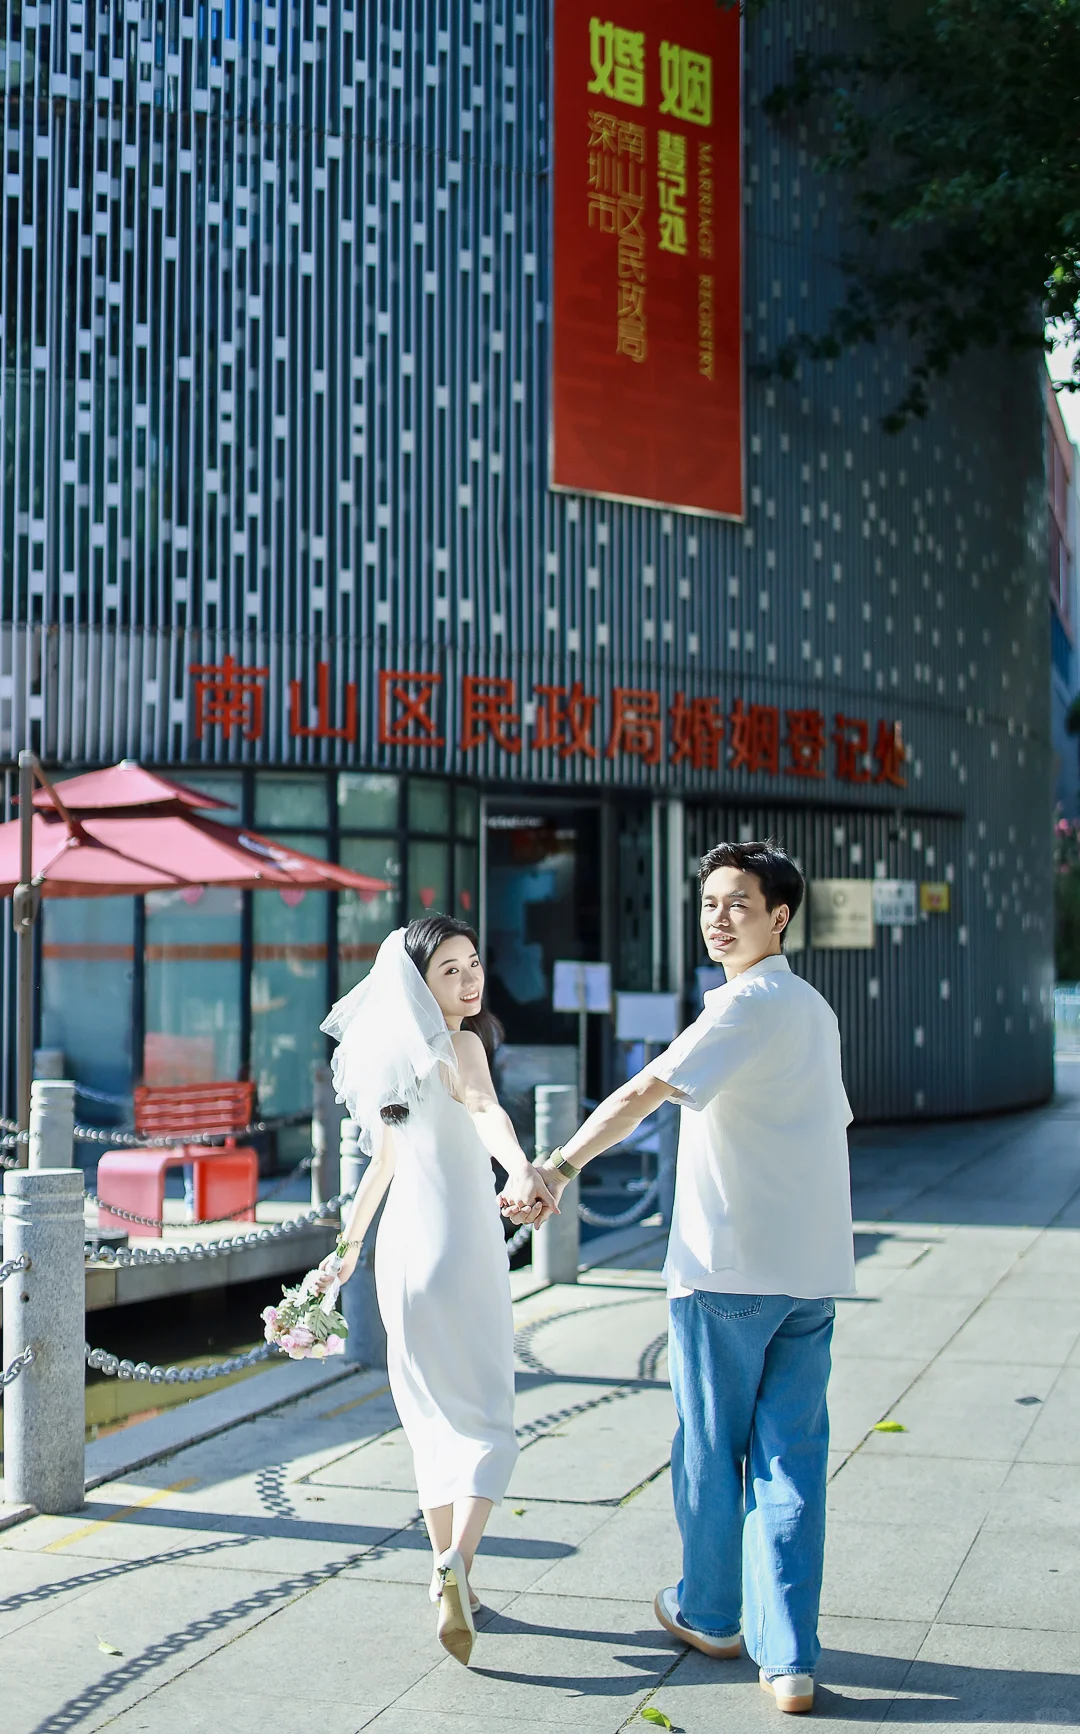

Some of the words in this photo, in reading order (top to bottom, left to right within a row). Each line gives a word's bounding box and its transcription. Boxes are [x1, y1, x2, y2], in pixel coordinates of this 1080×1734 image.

[587, 16, 712, 127] 婚姻
[587, 109, 617, 235] 深圳市
[657, 131, 688, 256] 登记处
[698, 141, 714, 259] MARRIAGE
[616, 119, 647, 364] 南山区民政局
[698, 274, 714, 380] REGISTRY
[189, 655, 907, 788] 南山区民政局婚姻登记处
